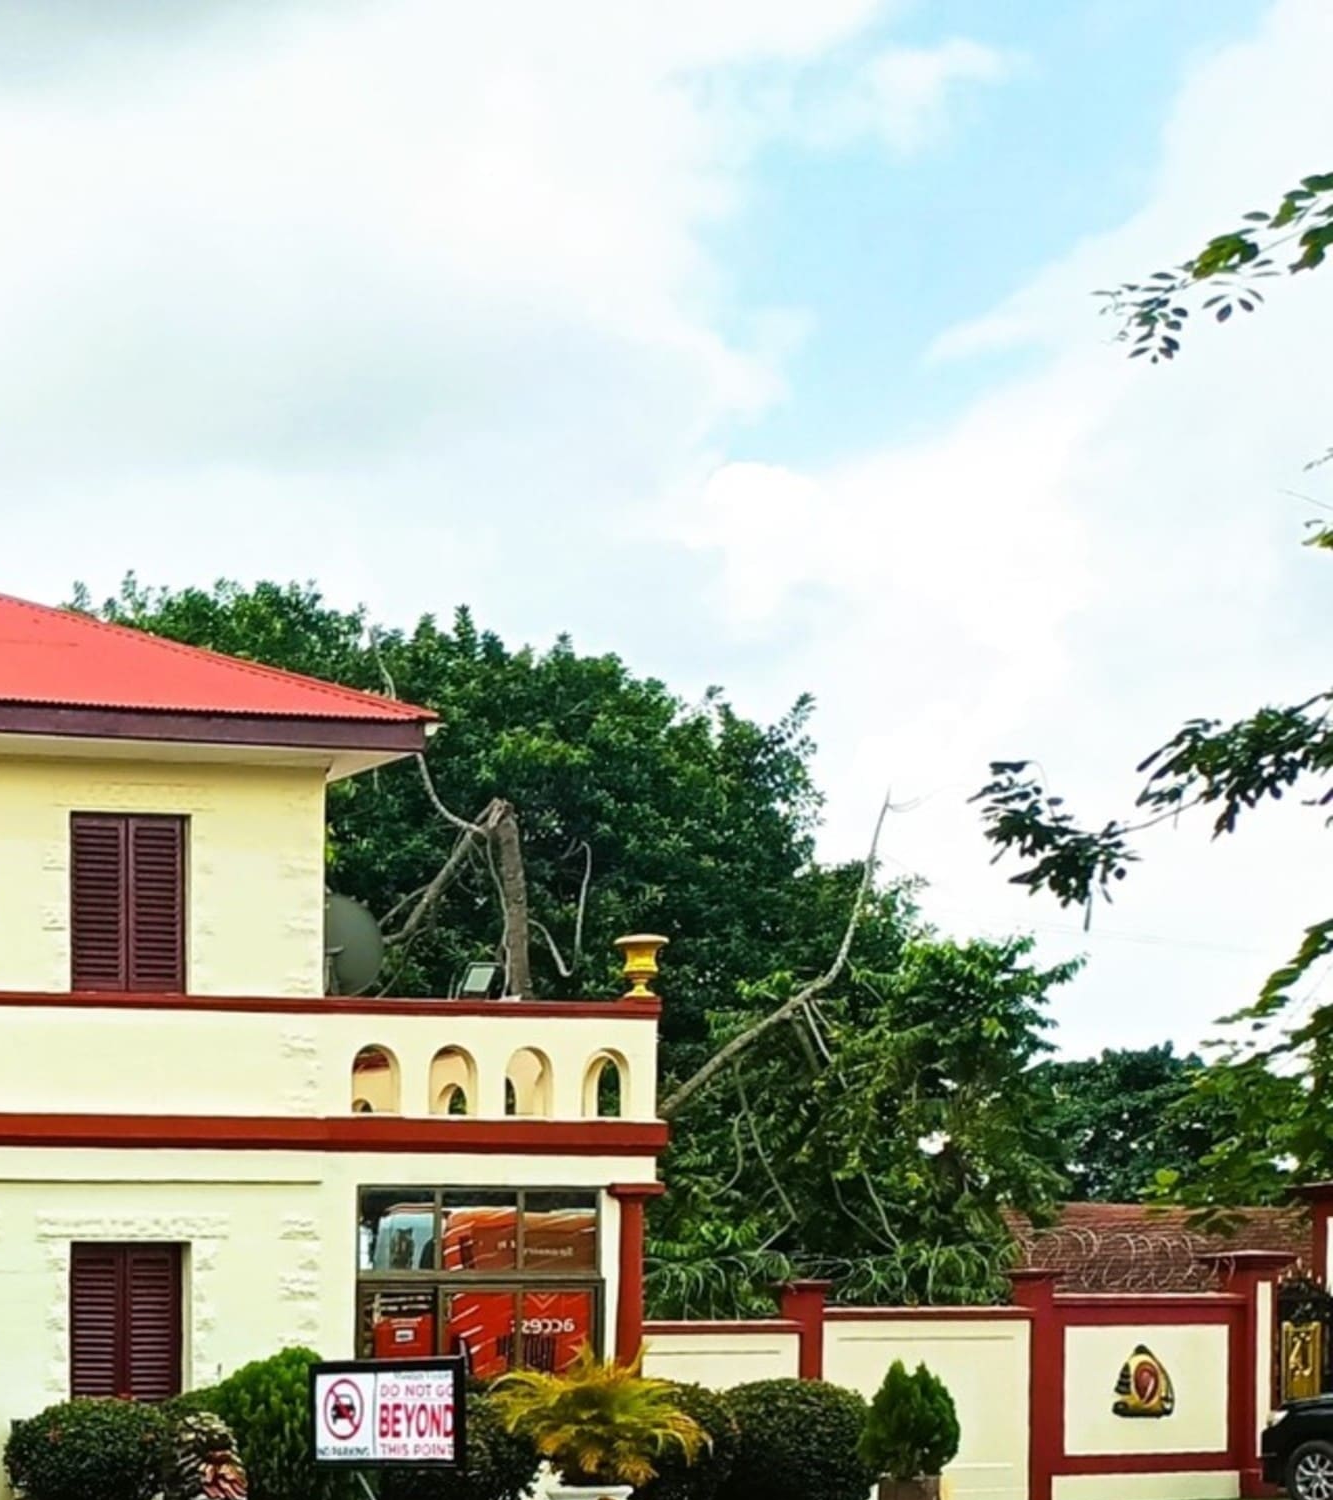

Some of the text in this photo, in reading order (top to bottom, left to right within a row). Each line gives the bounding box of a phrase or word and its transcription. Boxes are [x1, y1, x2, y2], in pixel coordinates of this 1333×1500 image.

[380, 1384, 400, 1397] DO
[405, 1384, 431, 1397] NOT
[379, 1403, 455, 1438] BEYOND
[380, 1444, 409, 1456] THIS
